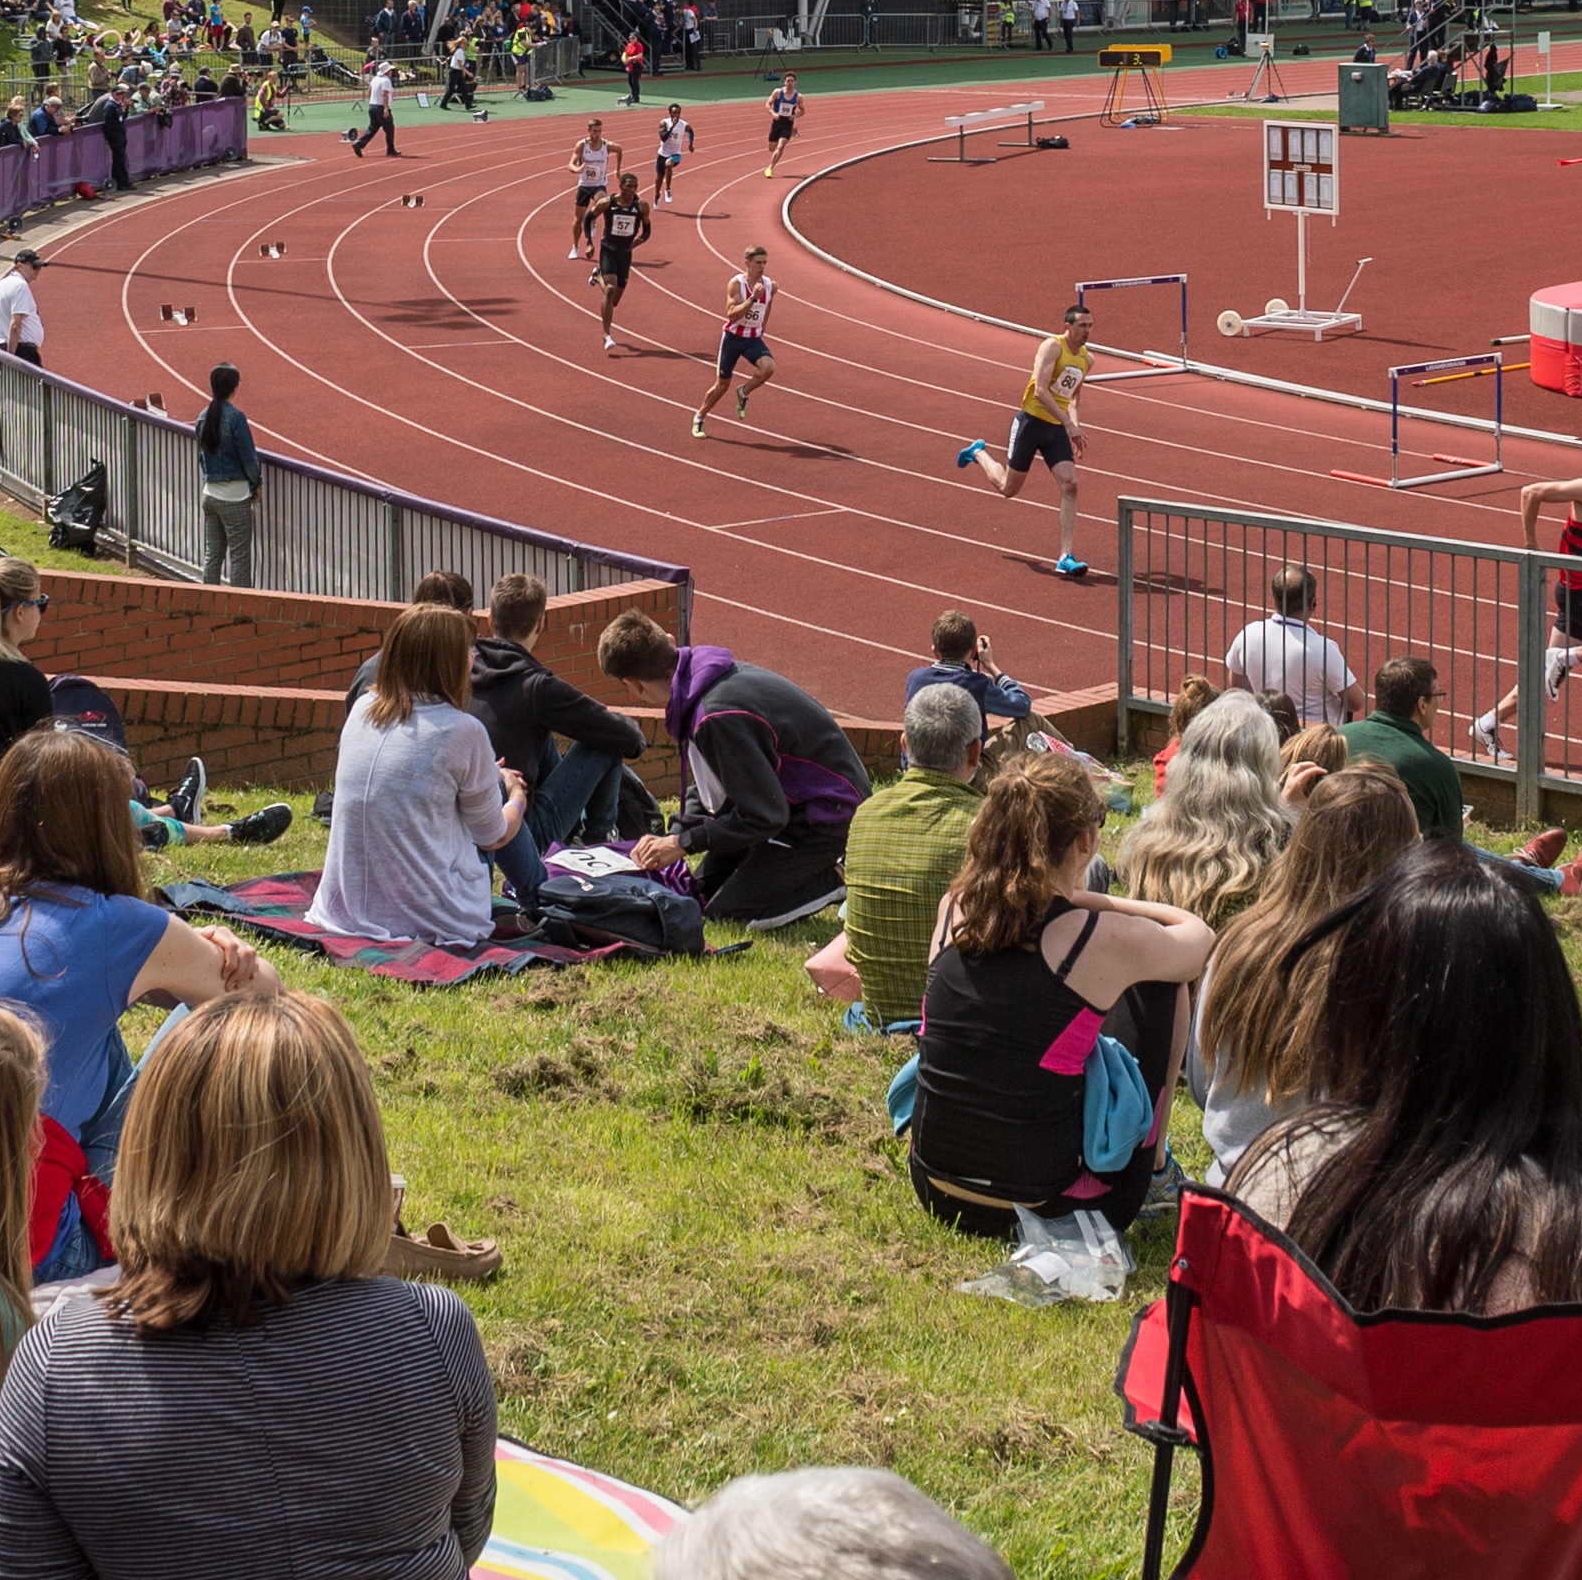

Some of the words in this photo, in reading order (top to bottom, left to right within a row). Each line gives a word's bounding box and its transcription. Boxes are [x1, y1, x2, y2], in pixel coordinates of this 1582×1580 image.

[617, 221, 630, 231] 57
[745, 310, 760, 321] 66
[1061, 375, 1077, 389] 80
